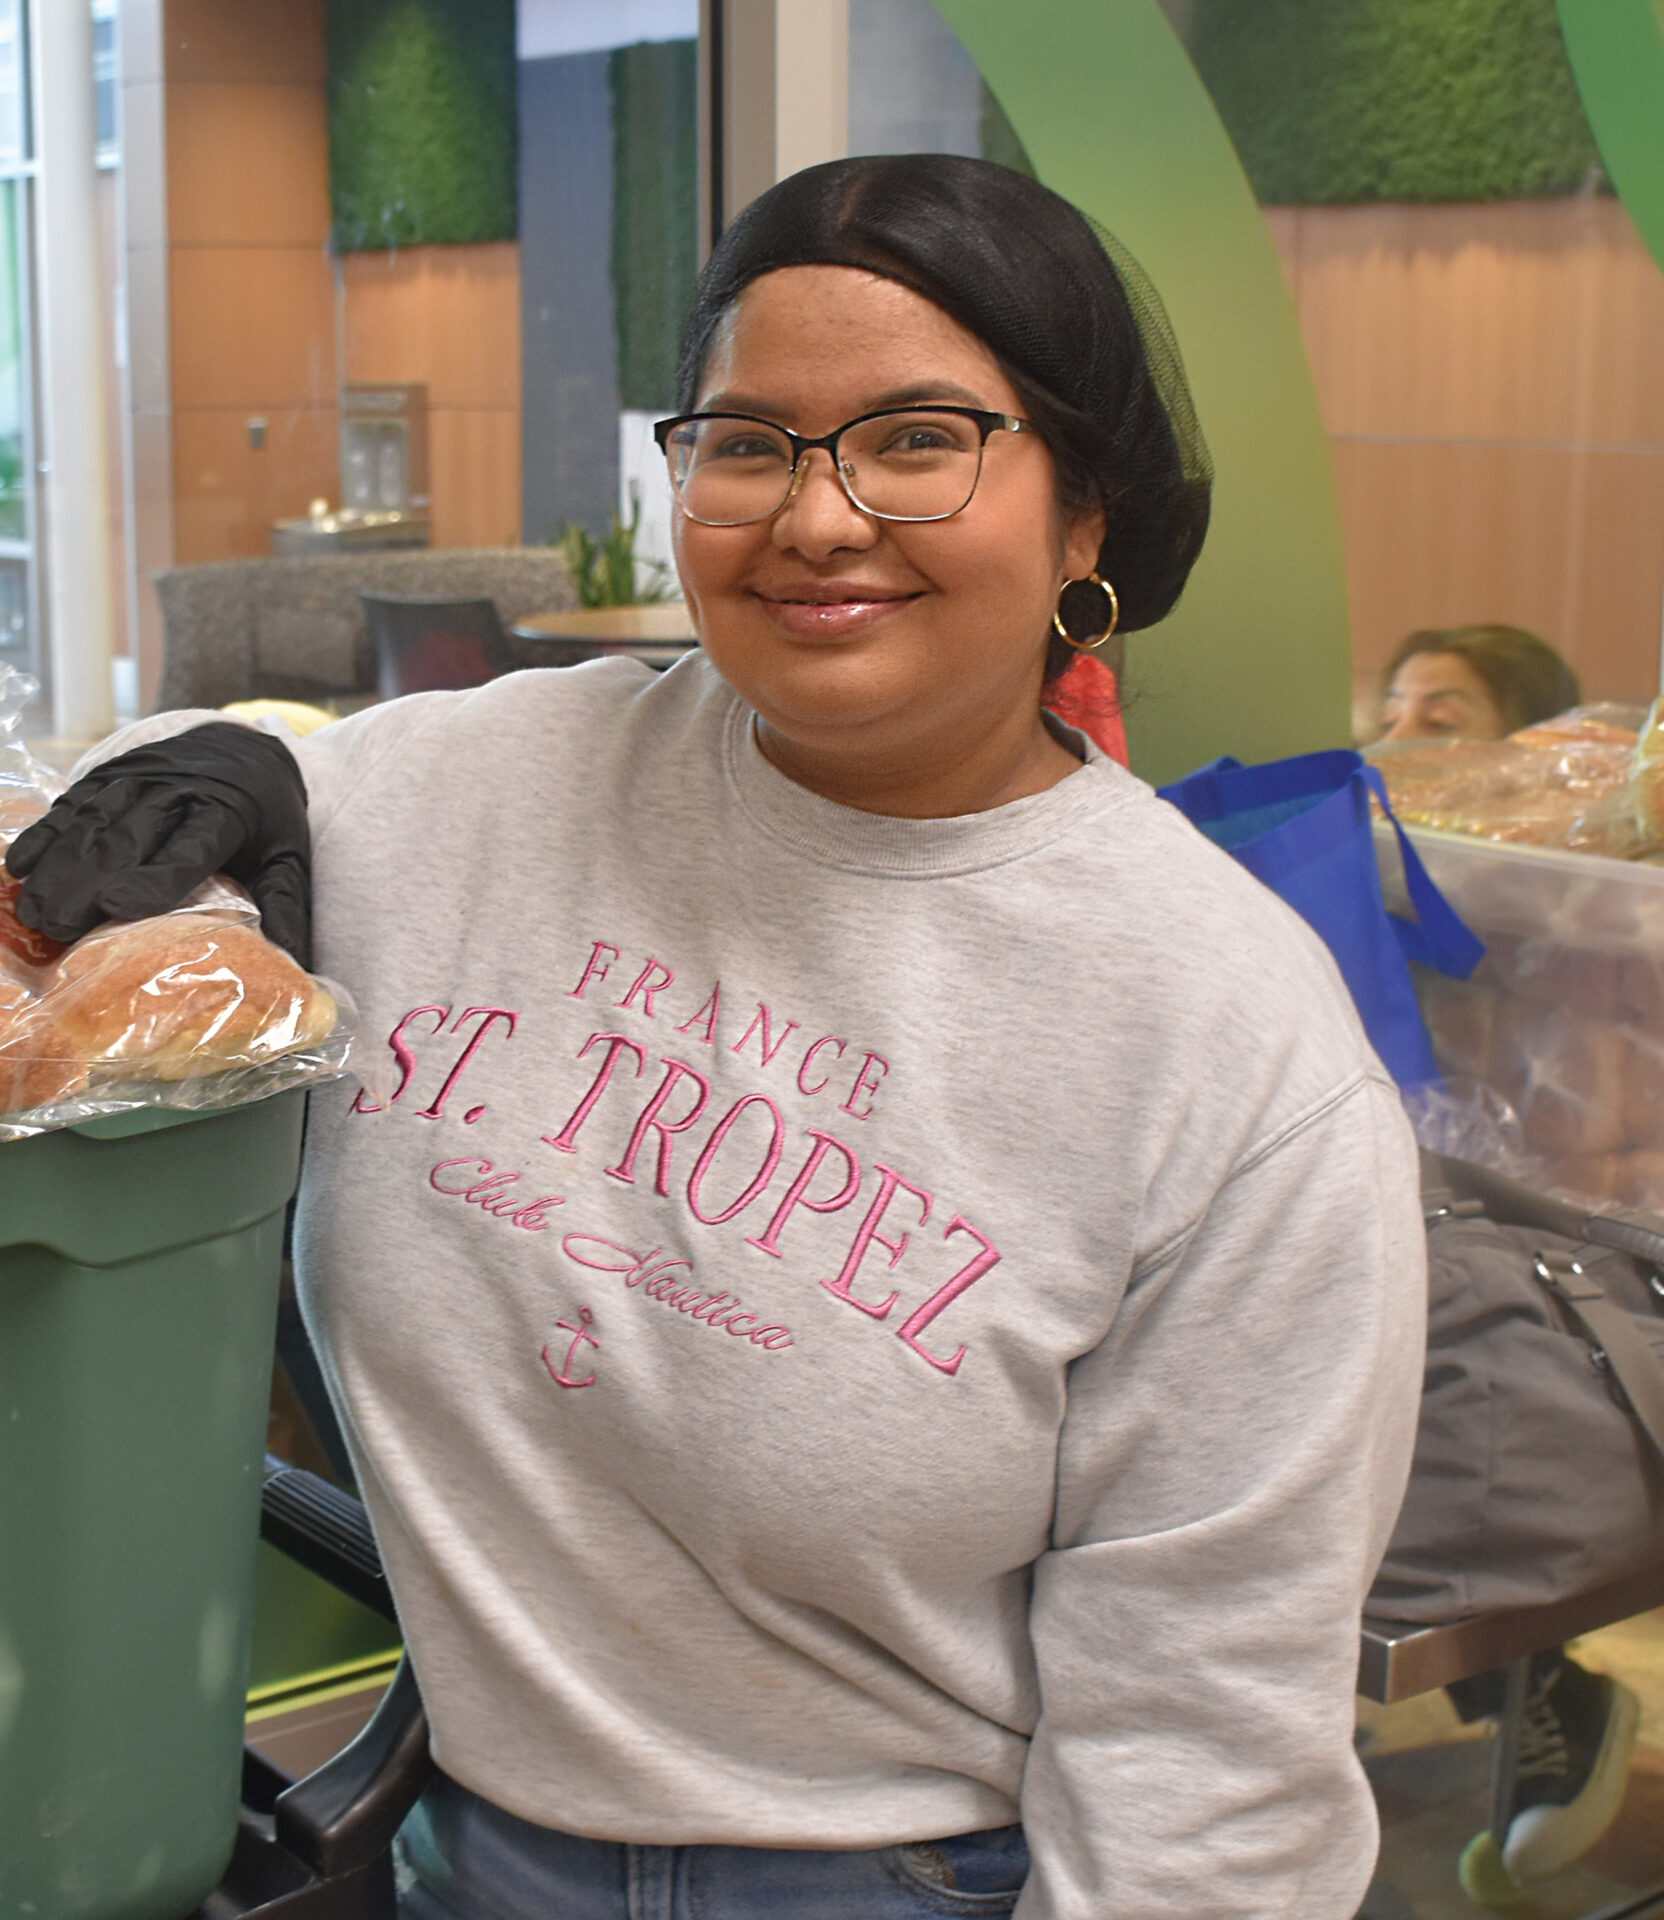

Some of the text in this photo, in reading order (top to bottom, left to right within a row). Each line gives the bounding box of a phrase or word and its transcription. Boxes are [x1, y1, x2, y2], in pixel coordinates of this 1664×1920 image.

[565, 940, 891, 1121] FRANCE
[349, 1004, 1003, 1376] ST. TROPEZ
[430, 1156, 795, 1351] Club Nautica
